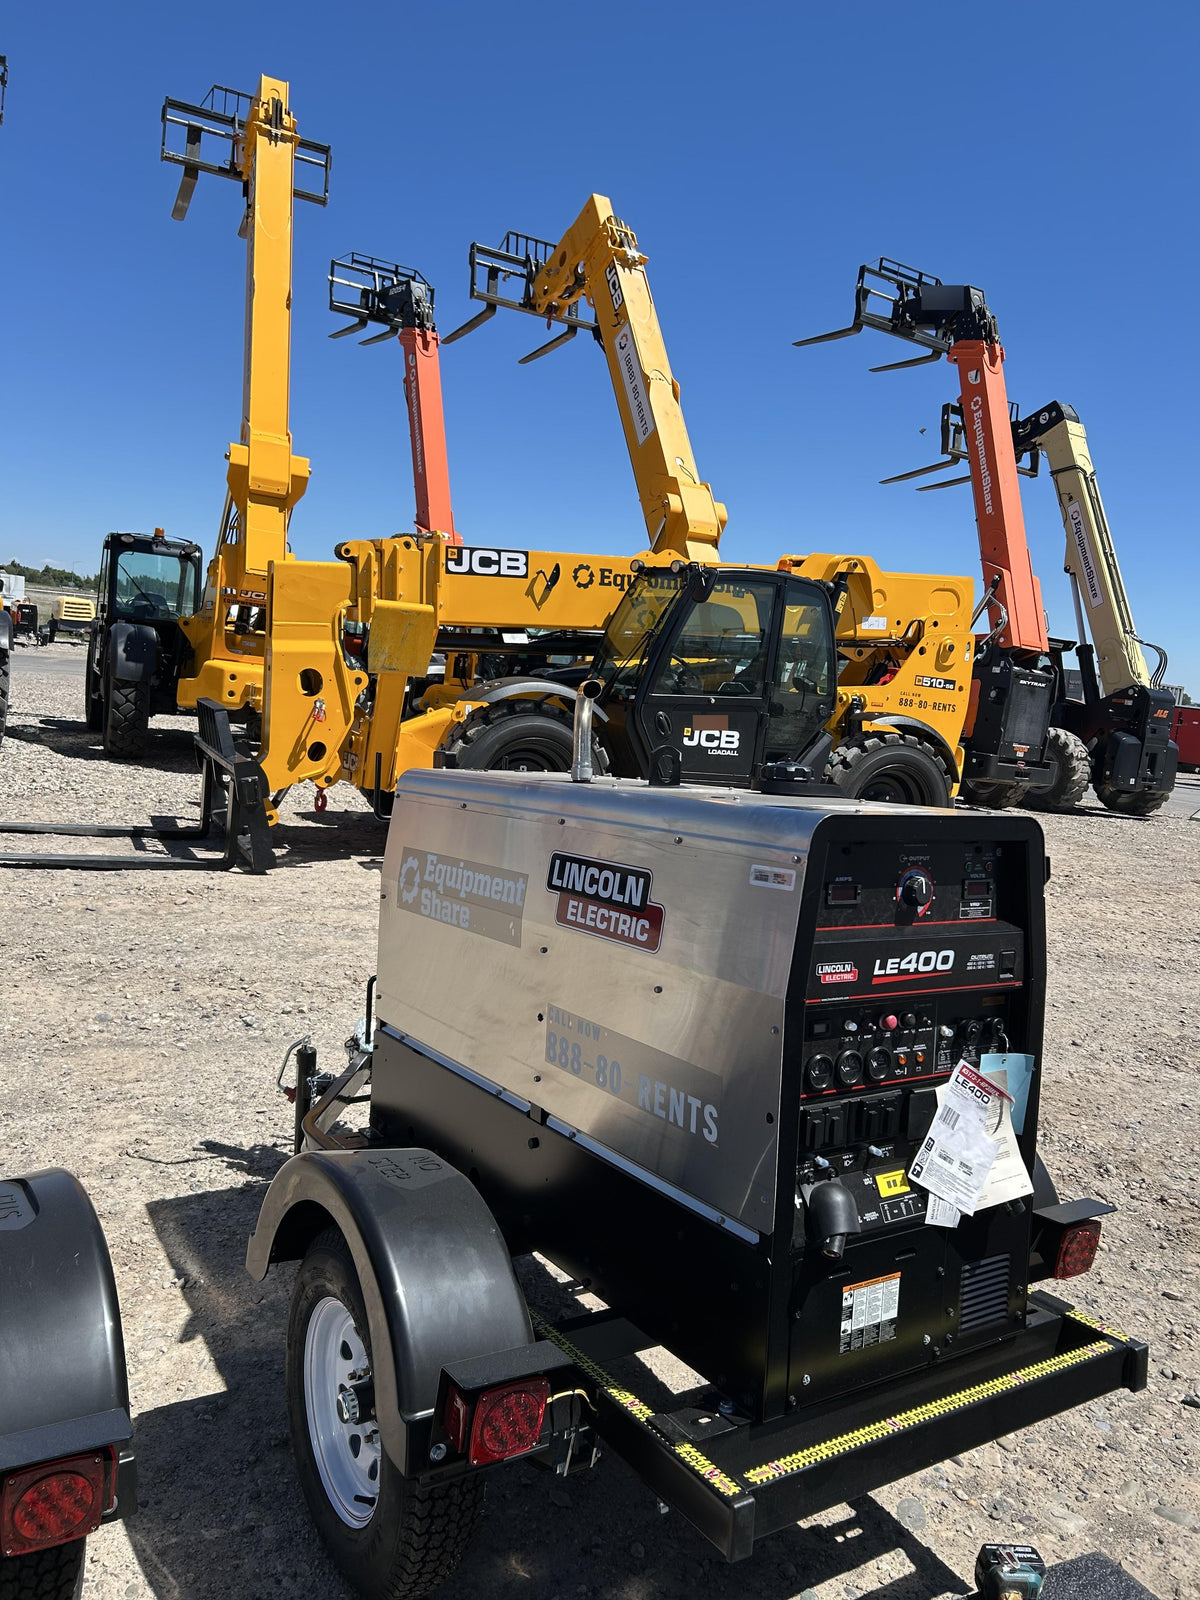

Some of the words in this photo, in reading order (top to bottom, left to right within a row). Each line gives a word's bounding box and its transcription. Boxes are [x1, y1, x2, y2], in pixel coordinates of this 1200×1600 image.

[605, 267, 624, 310] JCB
[624, 353, 636, 385] (888)
[631, 384, 649, 436] 80-RENTS
[972, 409, 993, 515] EquipmentShare
[447, 549, 527, 576] JCB
[1072, 519, 1098, 600] EquipmentShare
[241, 590, 267, 600] JC
[1019, 680, 1047, 688] SKYTRAK
[899, 697, 956, 712] 888-80-RENTS
[1154, 708, 1169, 719] JLG
[683, 730, 740, 748] JCB
[424, 854, 526, 906] Equipment
[551, 859, 645, 907] LINCOLN
[420, 888, 470, 928] Share
[566, 899, 650, 942] ELECTRIC
[818, 964, 852, 974] LINCOLN
[825, 973, 854, 982] ELECTRIC
[873, 950, 955, 975] LE400
[548, 1006, 572, 1030] CALL
[577, 1019, 601, 1041] NOW
[546, 1031, 719, 1143] 888-80-RENTS
[954, 1074, 991, 1105] LE400
[367, 1157, 412, 1180] STEP
[409, 1156, 443, 1171] NO
[913, 1408, 935, 1421] PAS
[934, 1396, 965, 1413] TENEZ
[964, 1383, 1000, 1402] DEBOUT
[684, 1448, 707, 1471] AQUI
[784, 1455, 801, 1467] DO
[802, 1446, 825, 1461] NOT
[825, 1434, 860, 1452] STAND
[862, 1425, 888, 1438] HERE
